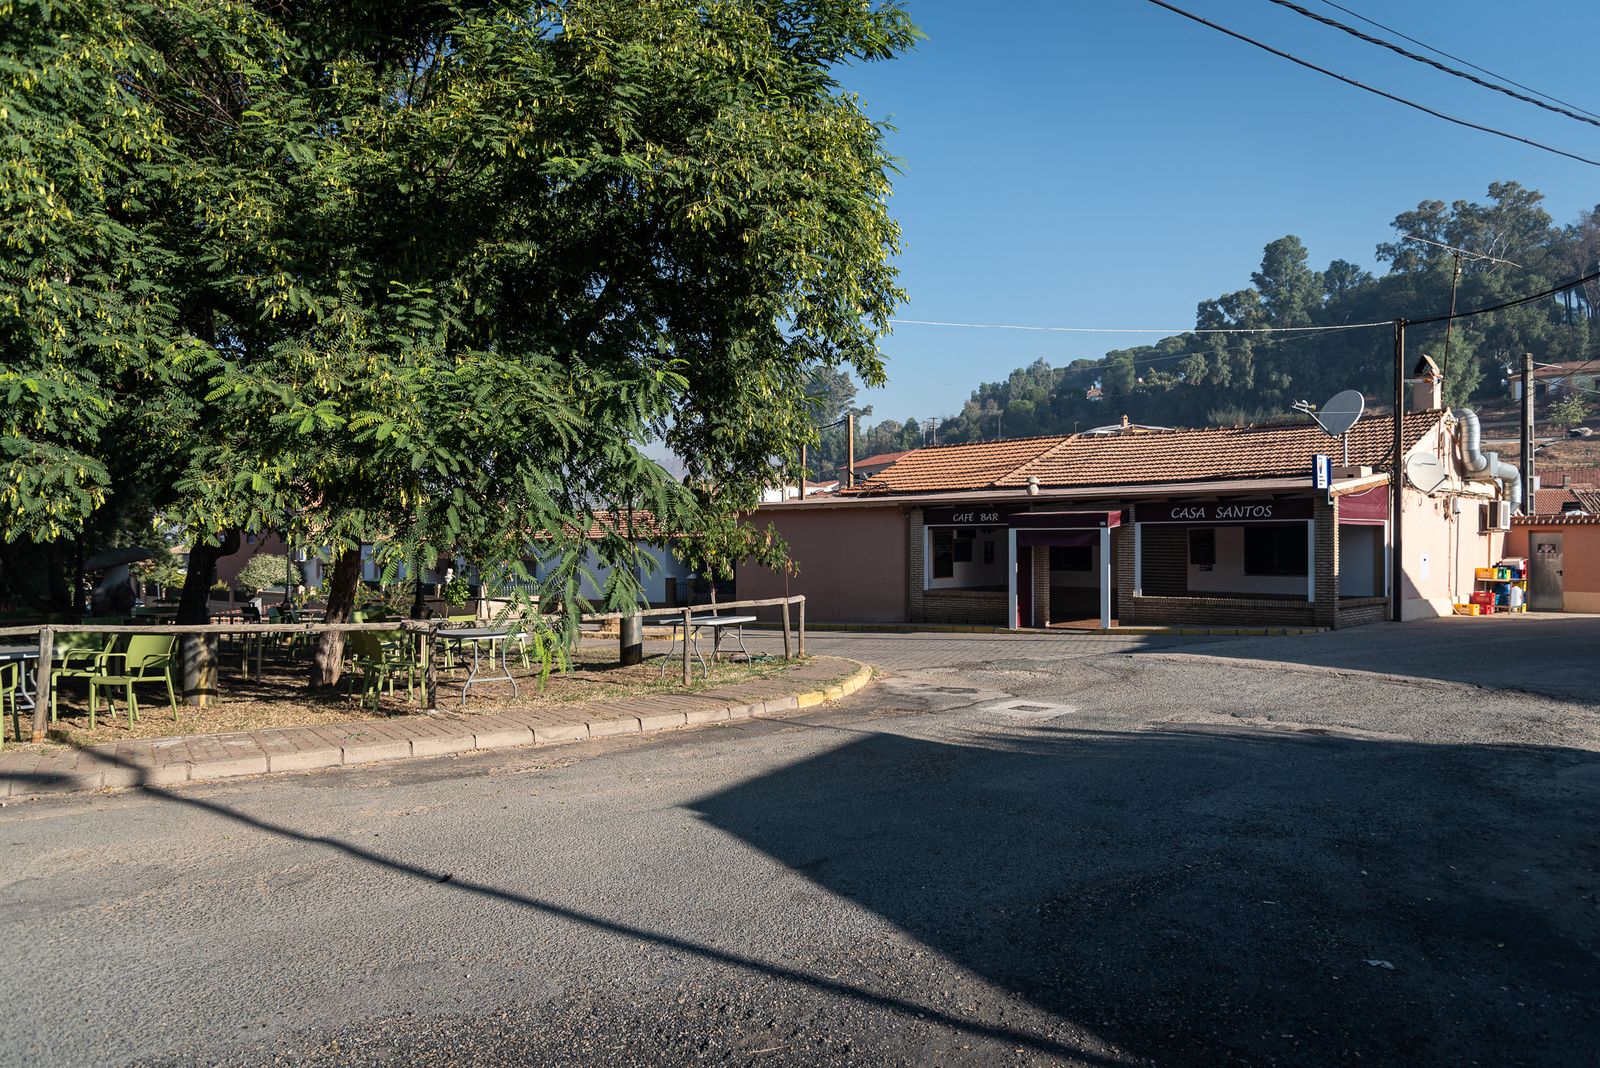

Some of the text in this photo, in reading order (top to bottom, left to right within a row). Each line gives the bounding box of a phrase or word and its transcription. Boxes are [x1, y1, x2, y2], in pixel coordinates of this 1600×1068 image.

[952, 511, 999, 523] CAFÉ BAR
[1171, 505, 1273, 519] CASA SANTOS
